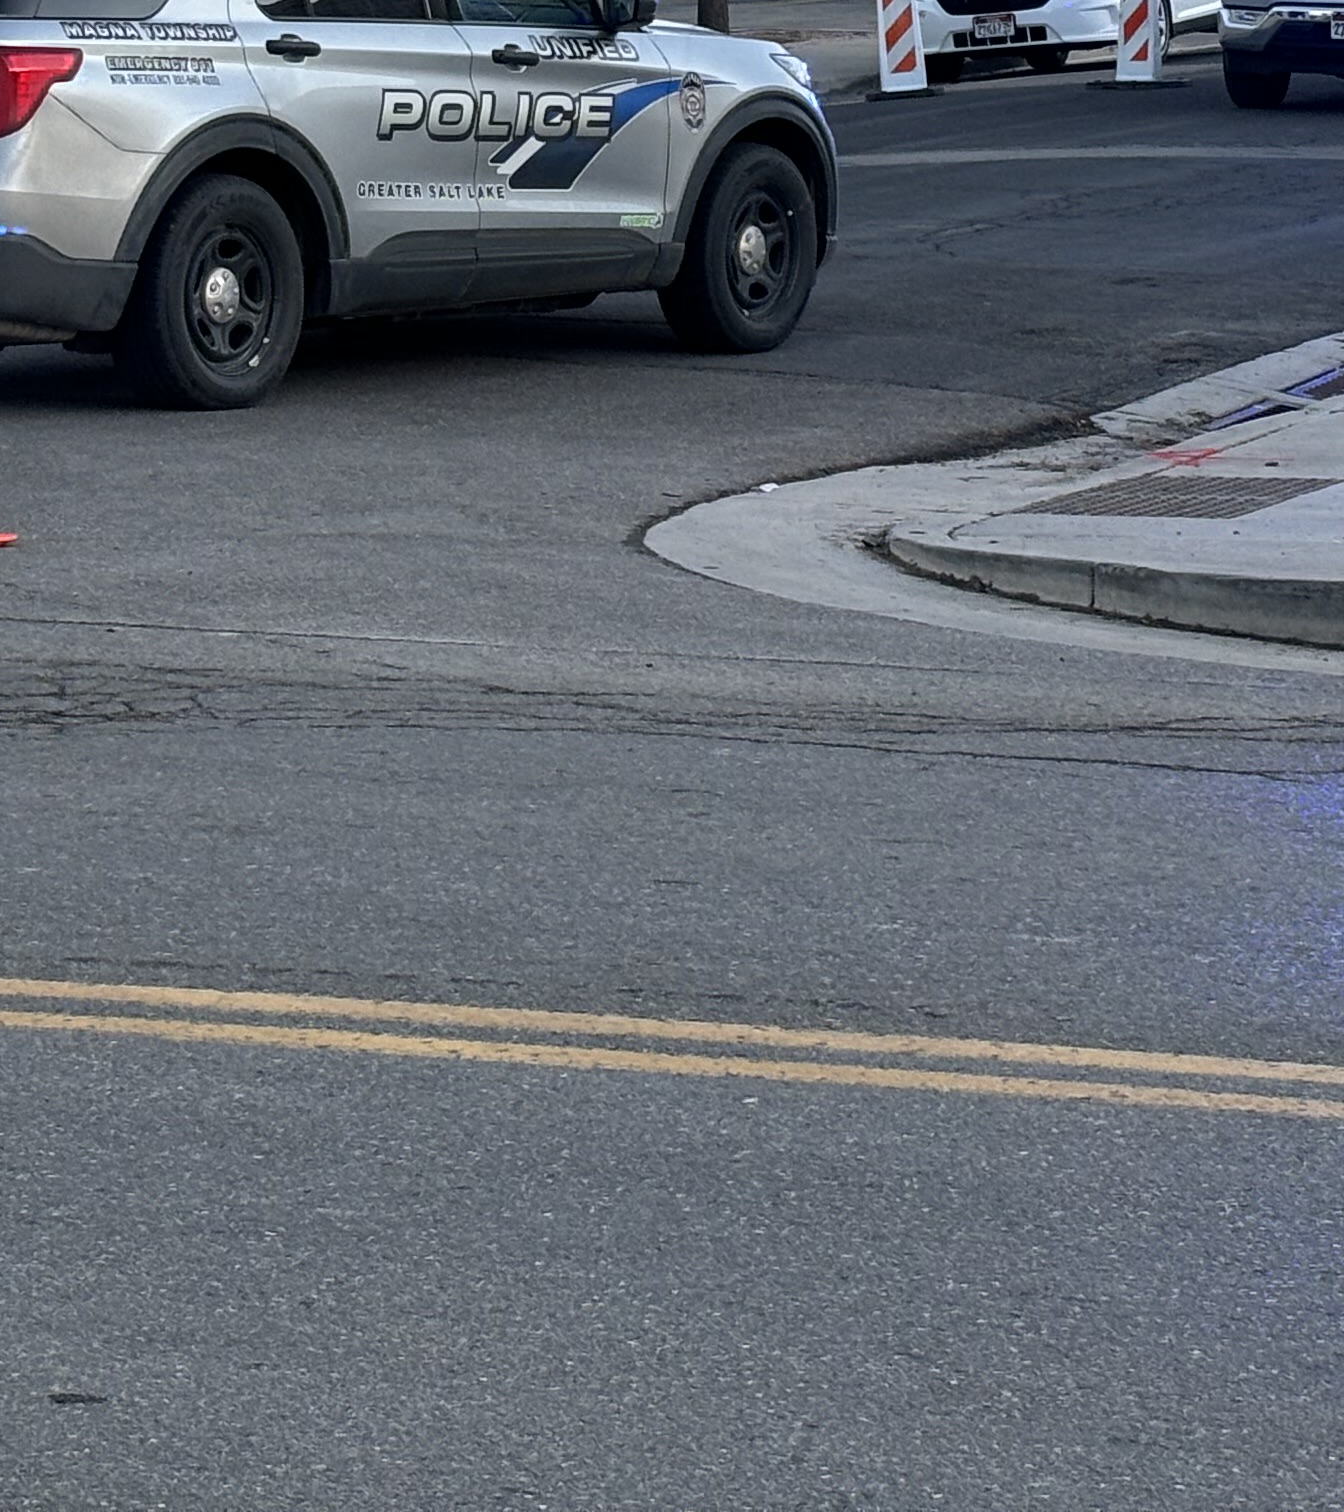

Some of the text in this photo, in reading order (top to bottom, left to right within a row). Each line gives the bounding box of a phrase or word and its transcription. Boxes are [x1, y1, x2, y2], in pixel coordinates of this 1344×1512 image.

[59, 21, 238, 41] MAGNA TOWNSHIP
[527, 34, 640, 62] UNIFIED
[105, 56, 216, 73] EMERGENCY 911
[376, 88, 616, 143] POLICE
[357, 181, 506, 200] GREATER SALT LAKE
